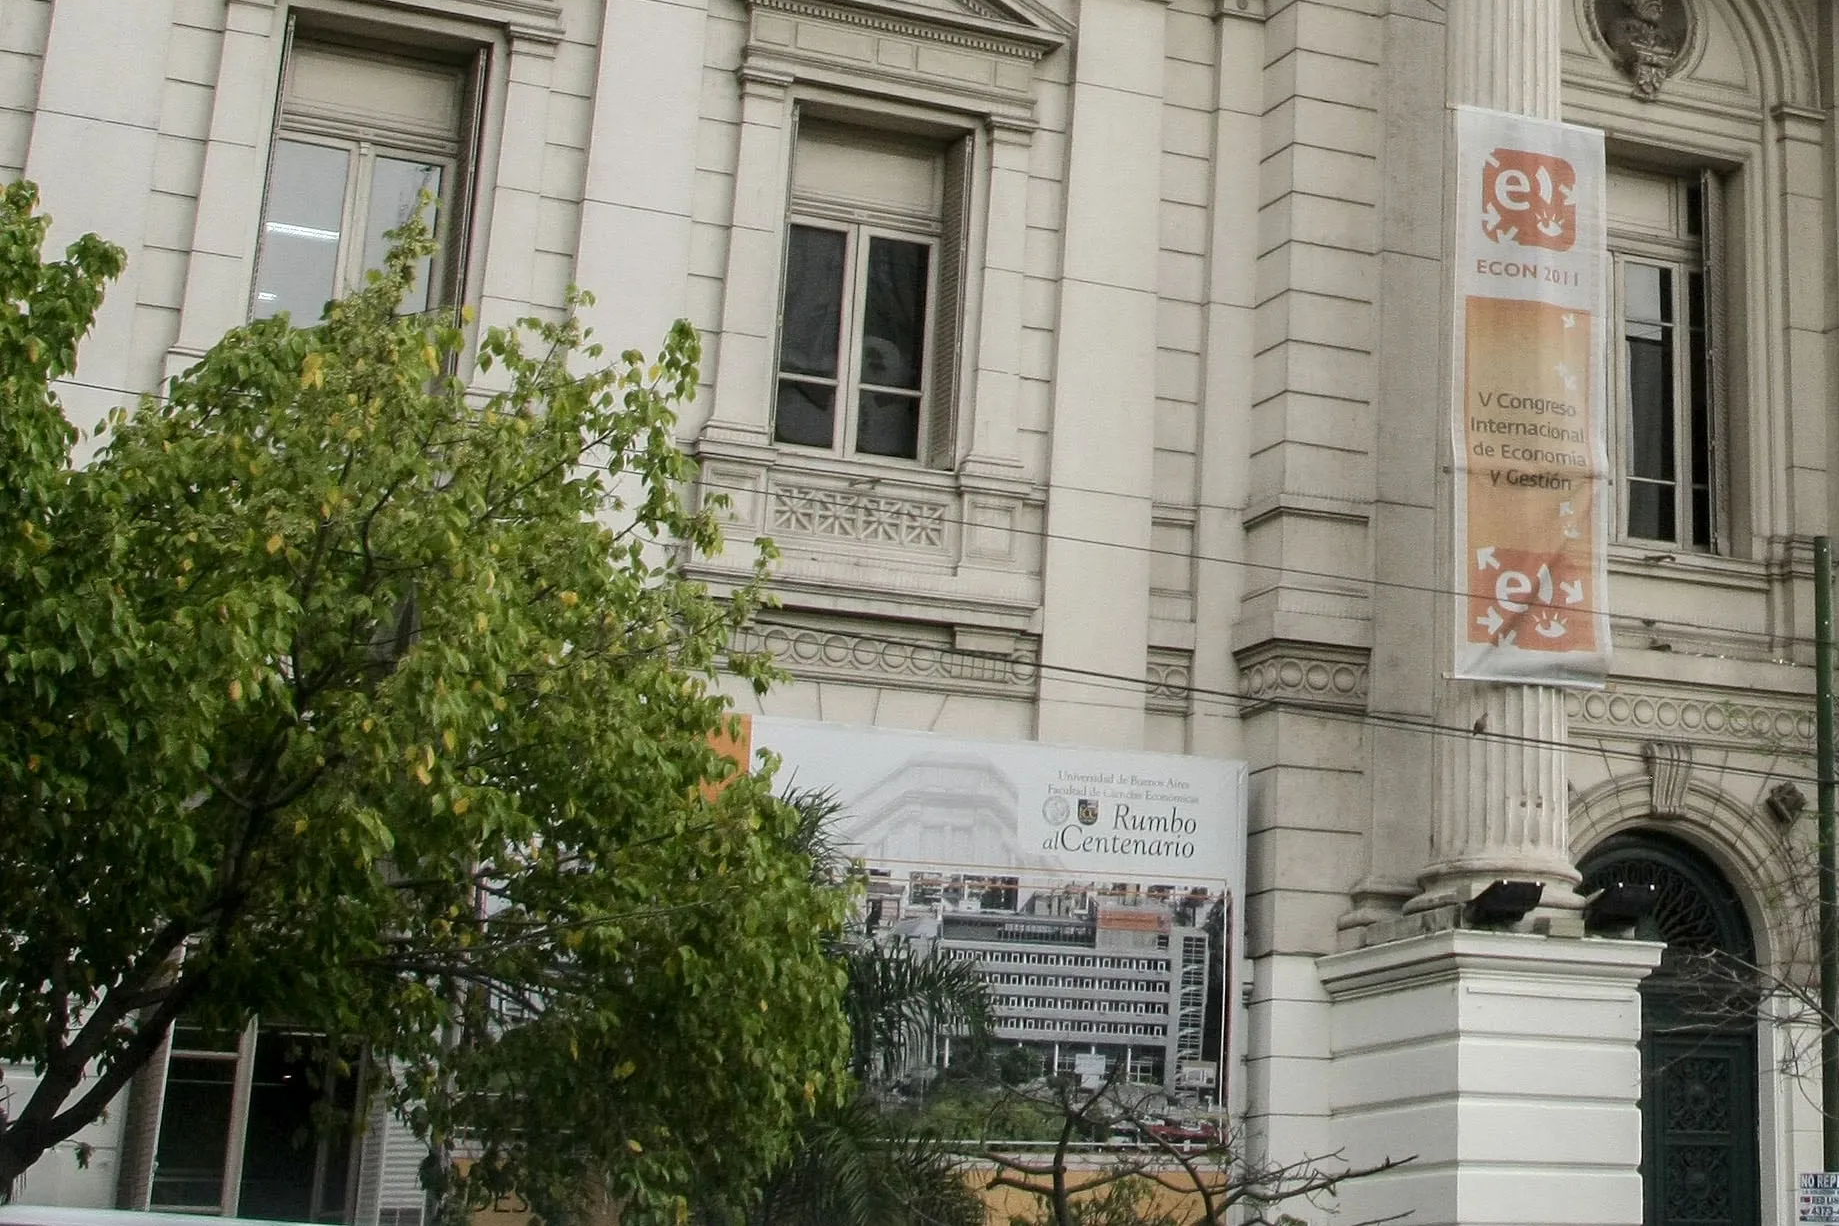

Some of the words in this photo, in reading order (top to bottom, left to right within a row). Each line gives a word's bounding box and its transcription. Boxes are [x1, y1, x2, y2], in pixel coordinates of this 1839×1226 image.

[1476, 259, 1537, 278] ECON
[1543, 267, 1578, 287] 2011
[1478, 391, 1493, 407] V
[1496, 393, 1577, 417] Congreso
[1470, 417, 1585, 443] Internacional
[1473, 442, 1496, 457] de
[1506, 468, 1572, 491] Gestión
[1048, 784, 1087, 797] Facultad
[1058, 770, 1114, 784] Universidad
[1118, 774, 1128, 784] de
[1131, 776, 1164, 787] Buenos
[1166, 778, 1190, 789] Aires
[1113, 803, 1197, 834] Rumbo
[1801, 1175, 1815, 1187] NO
